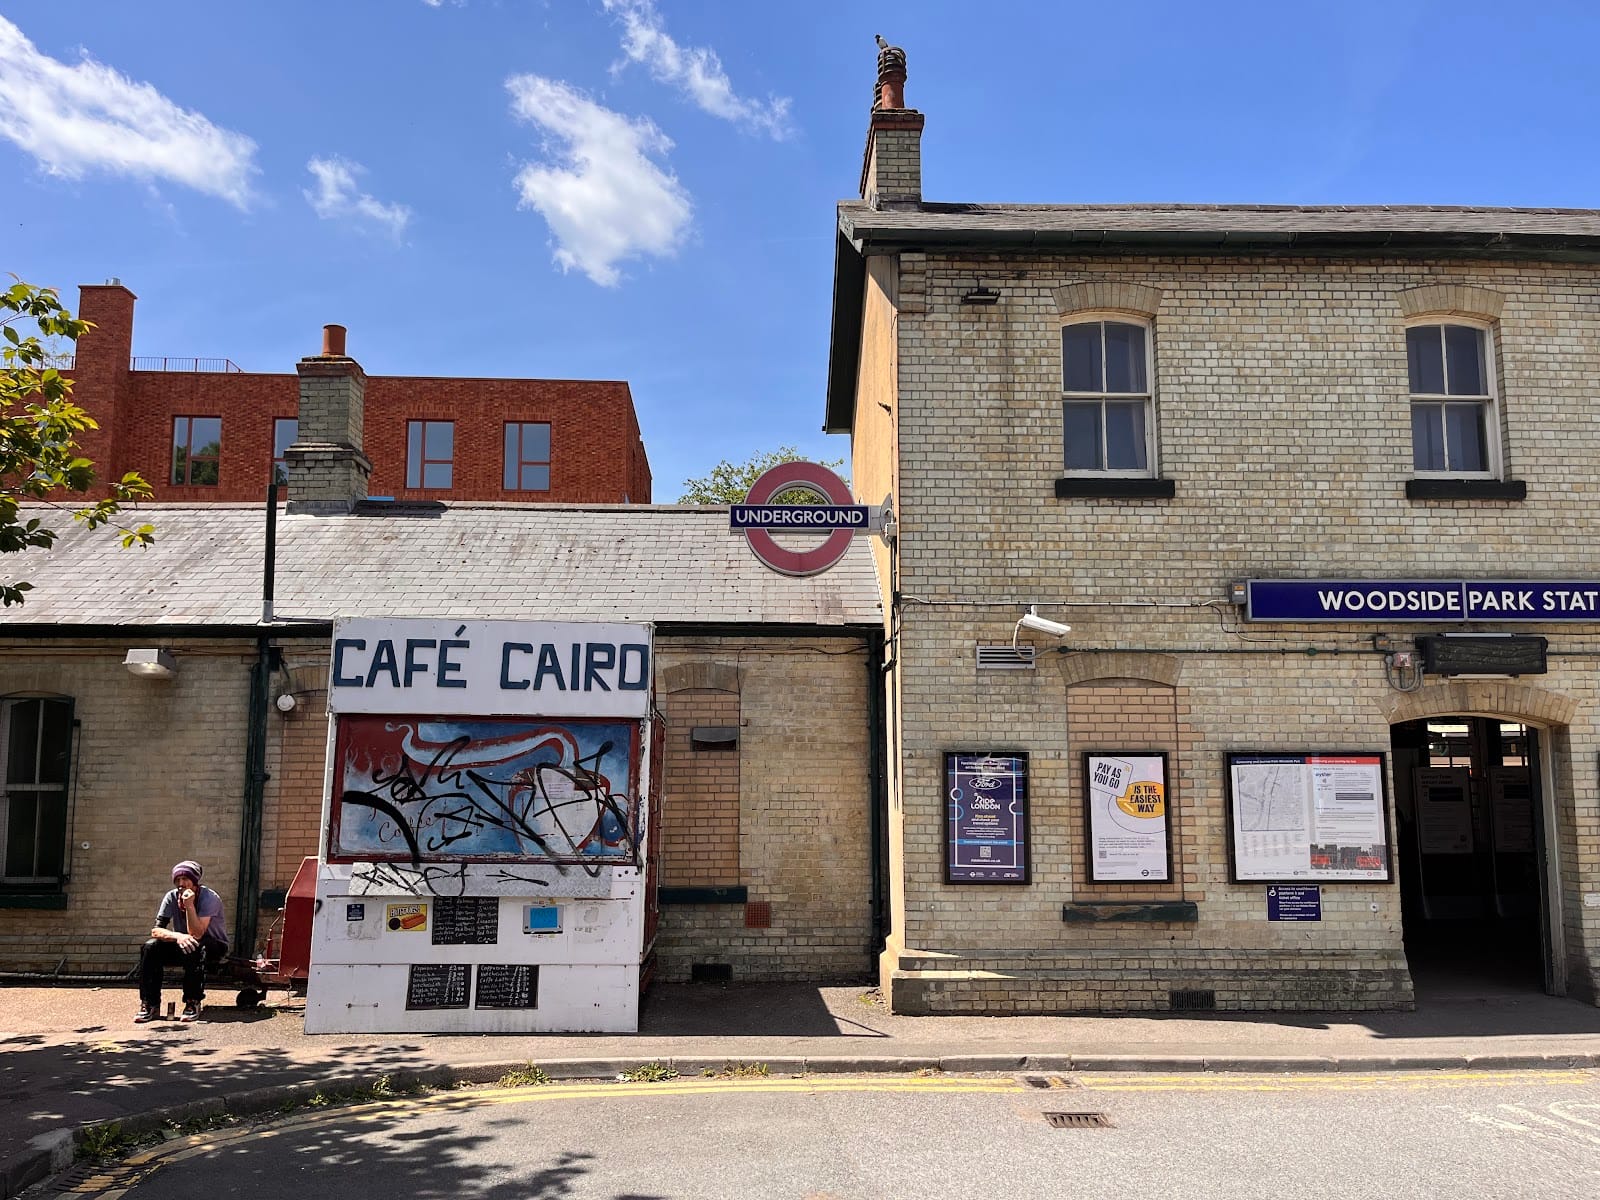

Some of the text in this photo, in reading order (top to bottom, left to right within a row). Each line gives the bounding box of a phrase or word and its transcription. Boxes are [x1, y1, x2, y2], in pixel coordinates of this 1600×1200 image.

[735, 509, 864, 524] UNDERGROUND
[1318, 590, 1461, 611] WOODSIDE
[1468, 590, 1535, 611] PARK
[333, 624, 650, 692] CAFÉ CAIRO
[1096, 762, 1122, 779] PAY AS
[974, 779, 996, 788] Ford
[1094, 772, 1120, 789] YOU GO
[1134, 785, 1157, 794] IS THE
[1130, 794, 1161, 804] EASIEST
[1137, 803, 1155, 813] WAY
